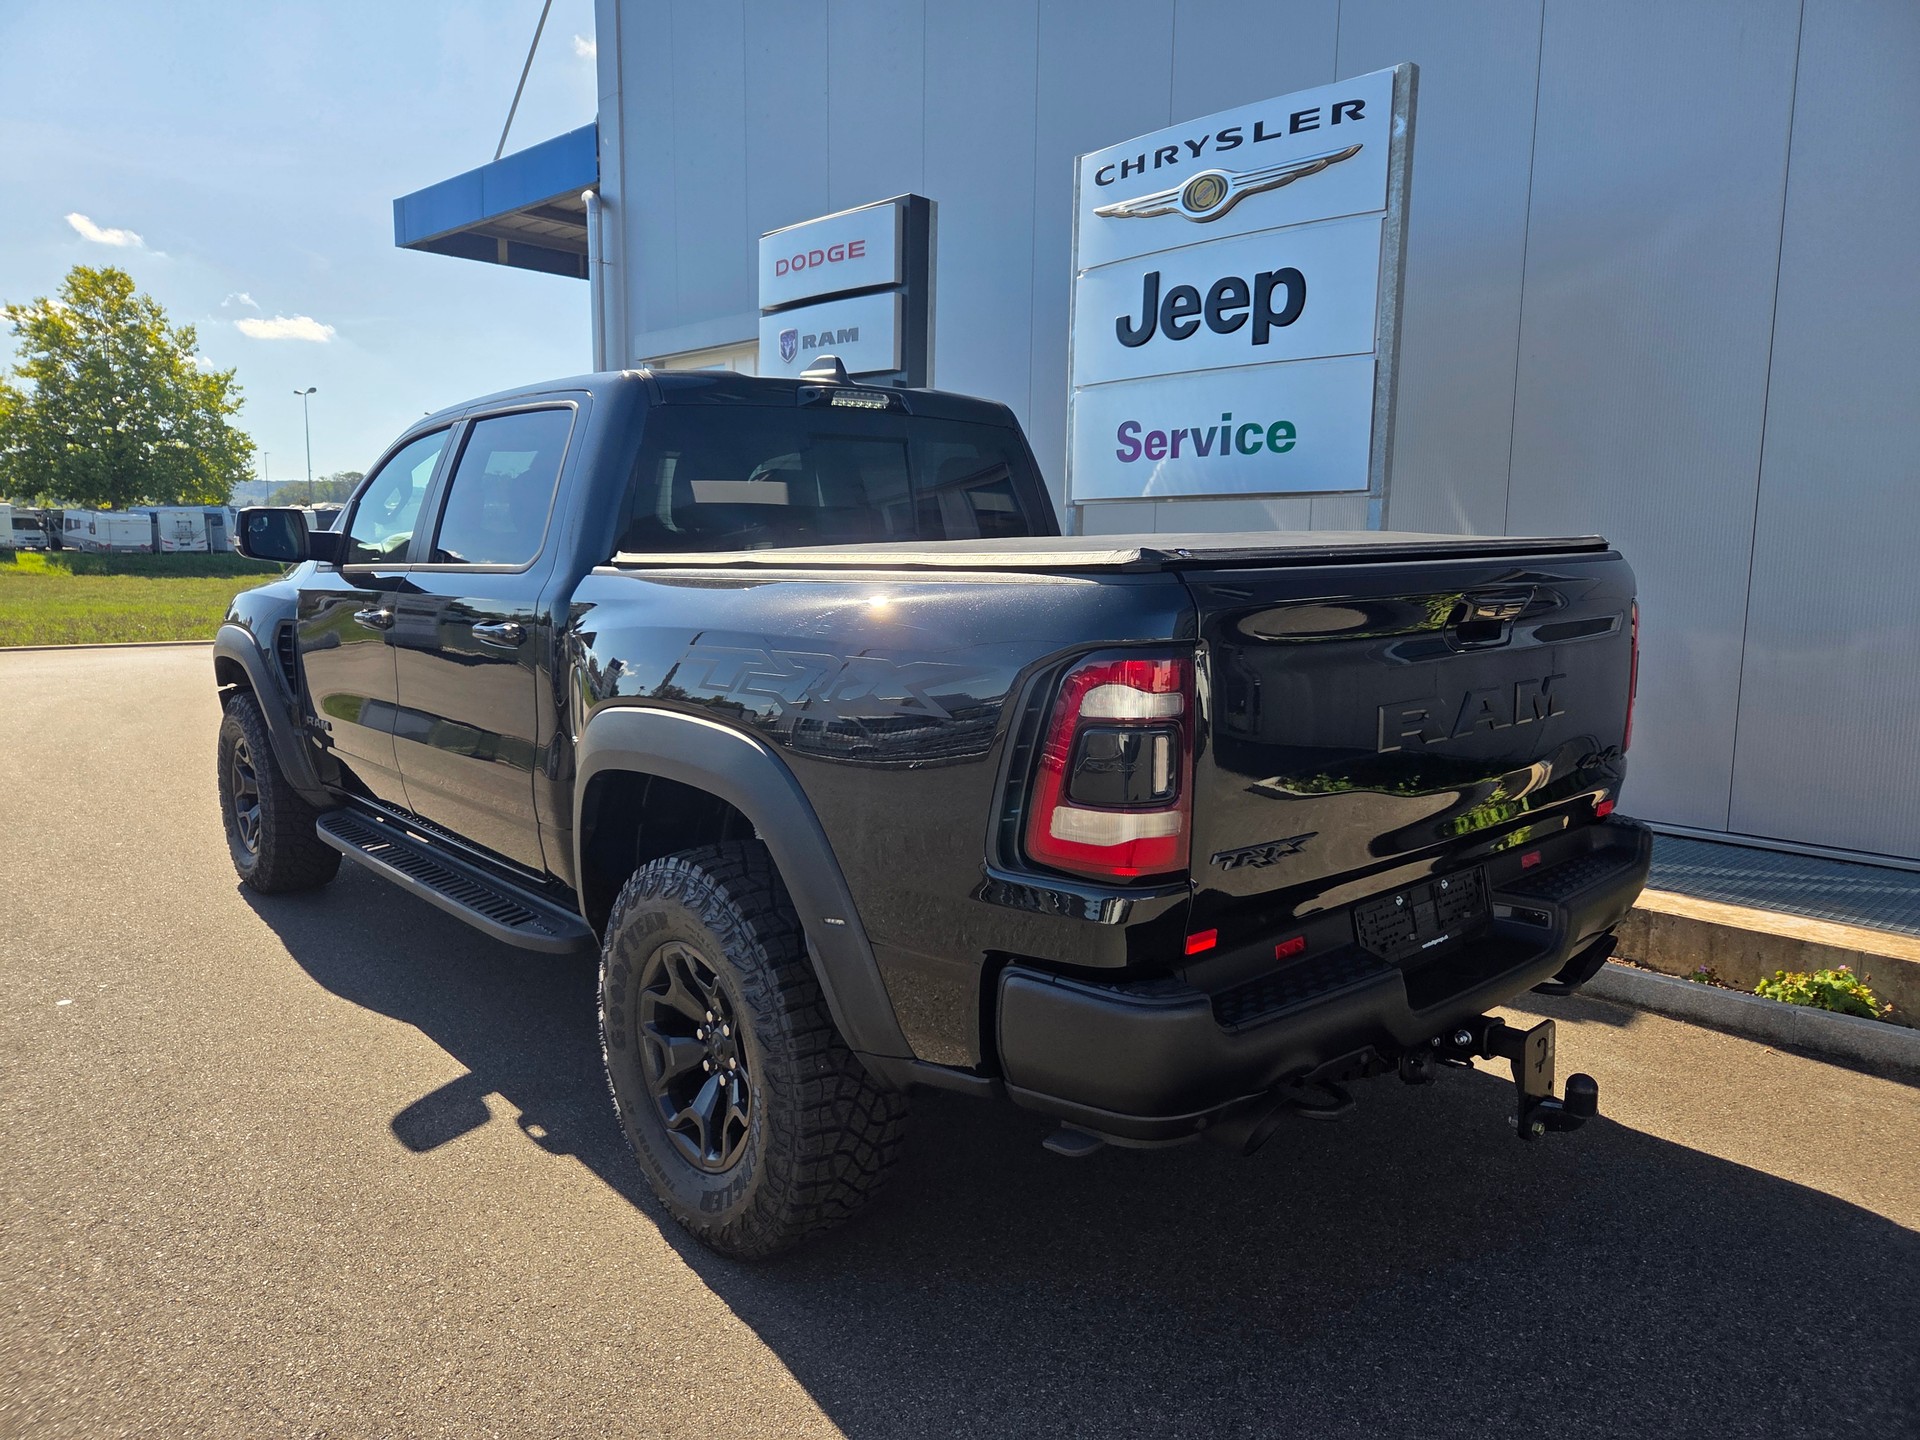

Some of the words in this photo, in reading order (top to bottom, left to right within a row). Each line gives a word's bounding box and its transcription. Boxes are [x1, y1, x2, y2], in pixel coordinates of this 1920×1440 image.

[1094, 99, 1366, 187] CHRYSLER
[775, 239, 866, 277] DODGE
[802, 327, 859, 350] RAM
[1115, 266, 1307, 348] Jeep
[1115, 412, 1297, 463] Service
[1377, 673, 1567, 754] RAM
